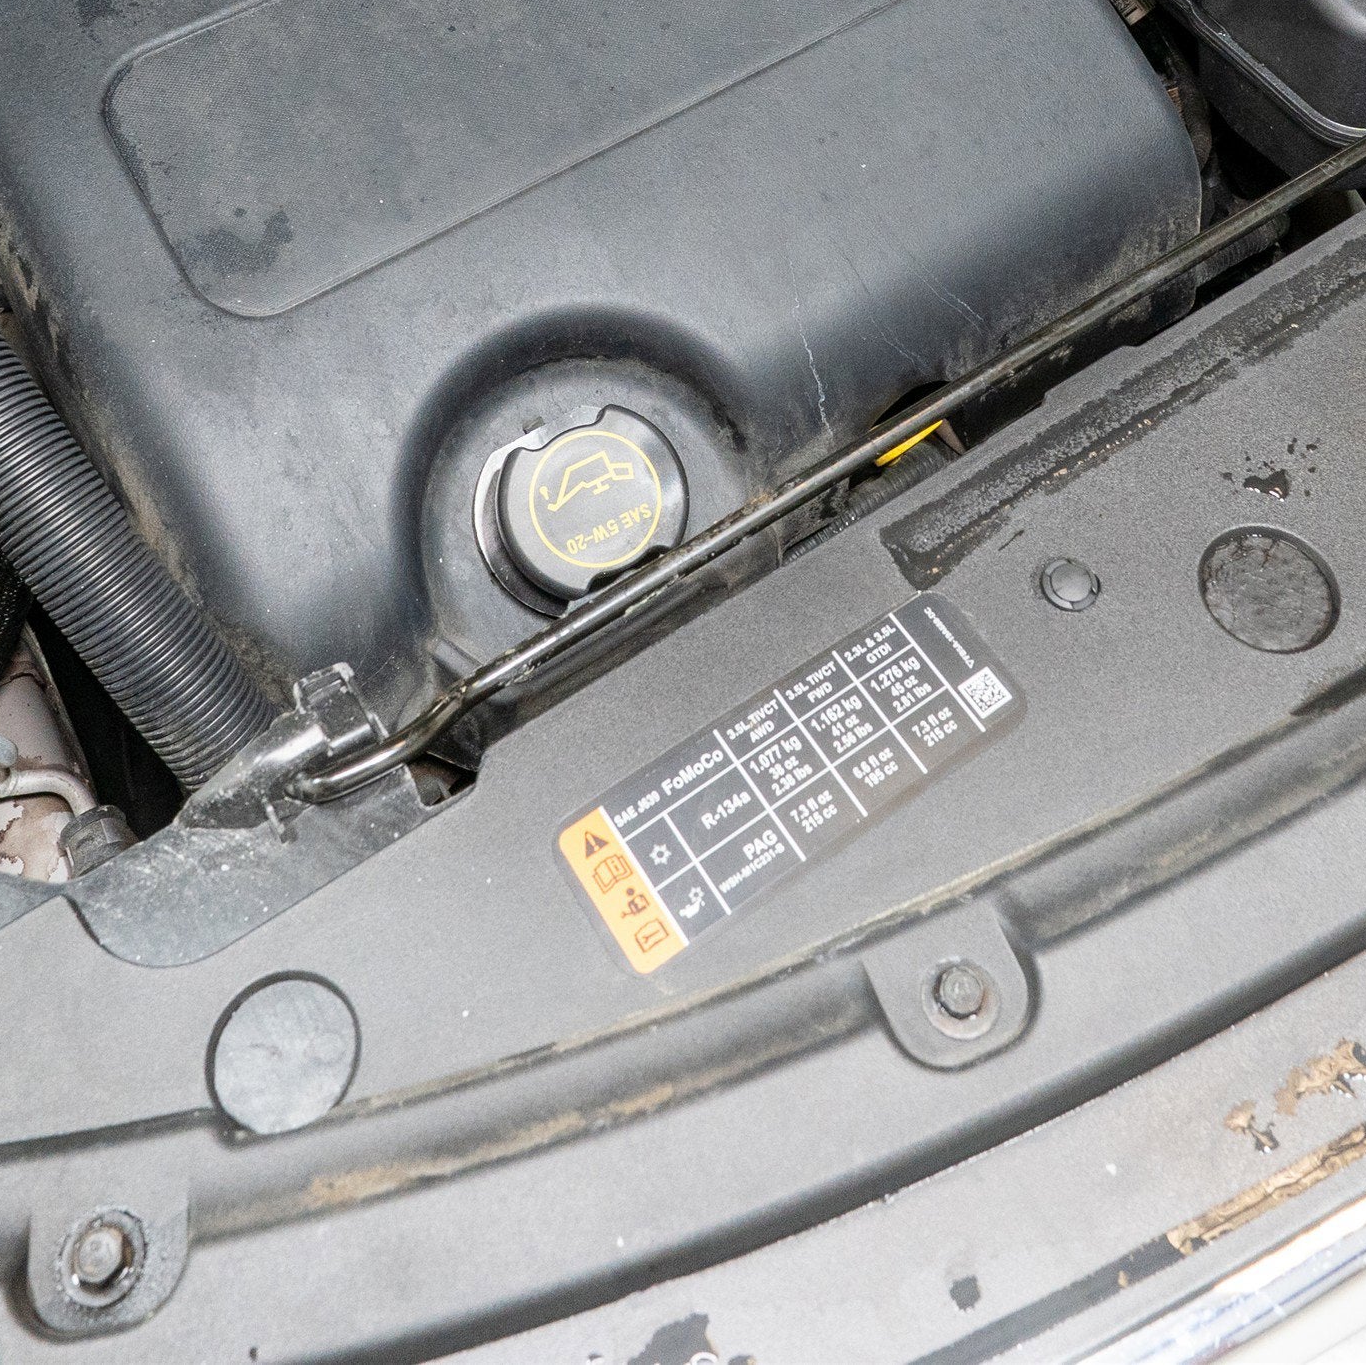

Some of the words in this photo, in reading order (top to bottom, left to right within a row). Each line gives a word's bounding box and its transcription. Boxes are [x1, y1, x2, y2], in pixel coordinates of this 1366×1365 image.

[624, 503, 653, 530] SAE
[566, 517, 621, 555] 5W-20
[844, 644, 867, 662] 2.3L
[865, 637, 876, 648] &
[873, 624, 896, 643] 3.5L
[866, 642, 892, 664] GTDI
[785, 682, 809, 701] 3.5L
[806, 661, 836, 685] TIVCT
[870, 664, 903, 693] 1.276
[899, 656, 921, 673] kg
[891, 681, 905, 696] 45
[904, 675, 919, 689] oz
[807, 681, 833, 703] FWD
[913, 682, 932, 698] lbs
[841, 695, 862, 712] kg
[726, 721, 750, 740] 3.5L
[747, 699, 779, 724] TIVCT
[749, 720, 775, 743] AWD
[831, 721, 846, 737] 41
[845, 714, 860, 729] oz
[854, 722, 874, 739] lbs
[911, 720, 931, 738] 7.3
[937, 707, 953, 721] oz
[943, 720, 958, 734] cc
[749, 744, 782, 774] 1.077
[780, 735, 802, 753] kg
[878, 747, 894, 762] oz
[768, 763, 785, 780] 38
[784, 756, 799, 770] oz
[793, 764, 813, 781] lbs
[884, 760, 899, 776] cc
[614, 805, 638, 828] SAE
[661, 749, 724, 796] FoMoCo
[700, 791, 751, 830] R-134a
[790, 804, 810, 823] 7.3
[817, 790, 833, 805] oz
[801, 811, 824, 833] 215
[822, 804, 838, 819] cc
[742, 829, 778, 861] PAG
